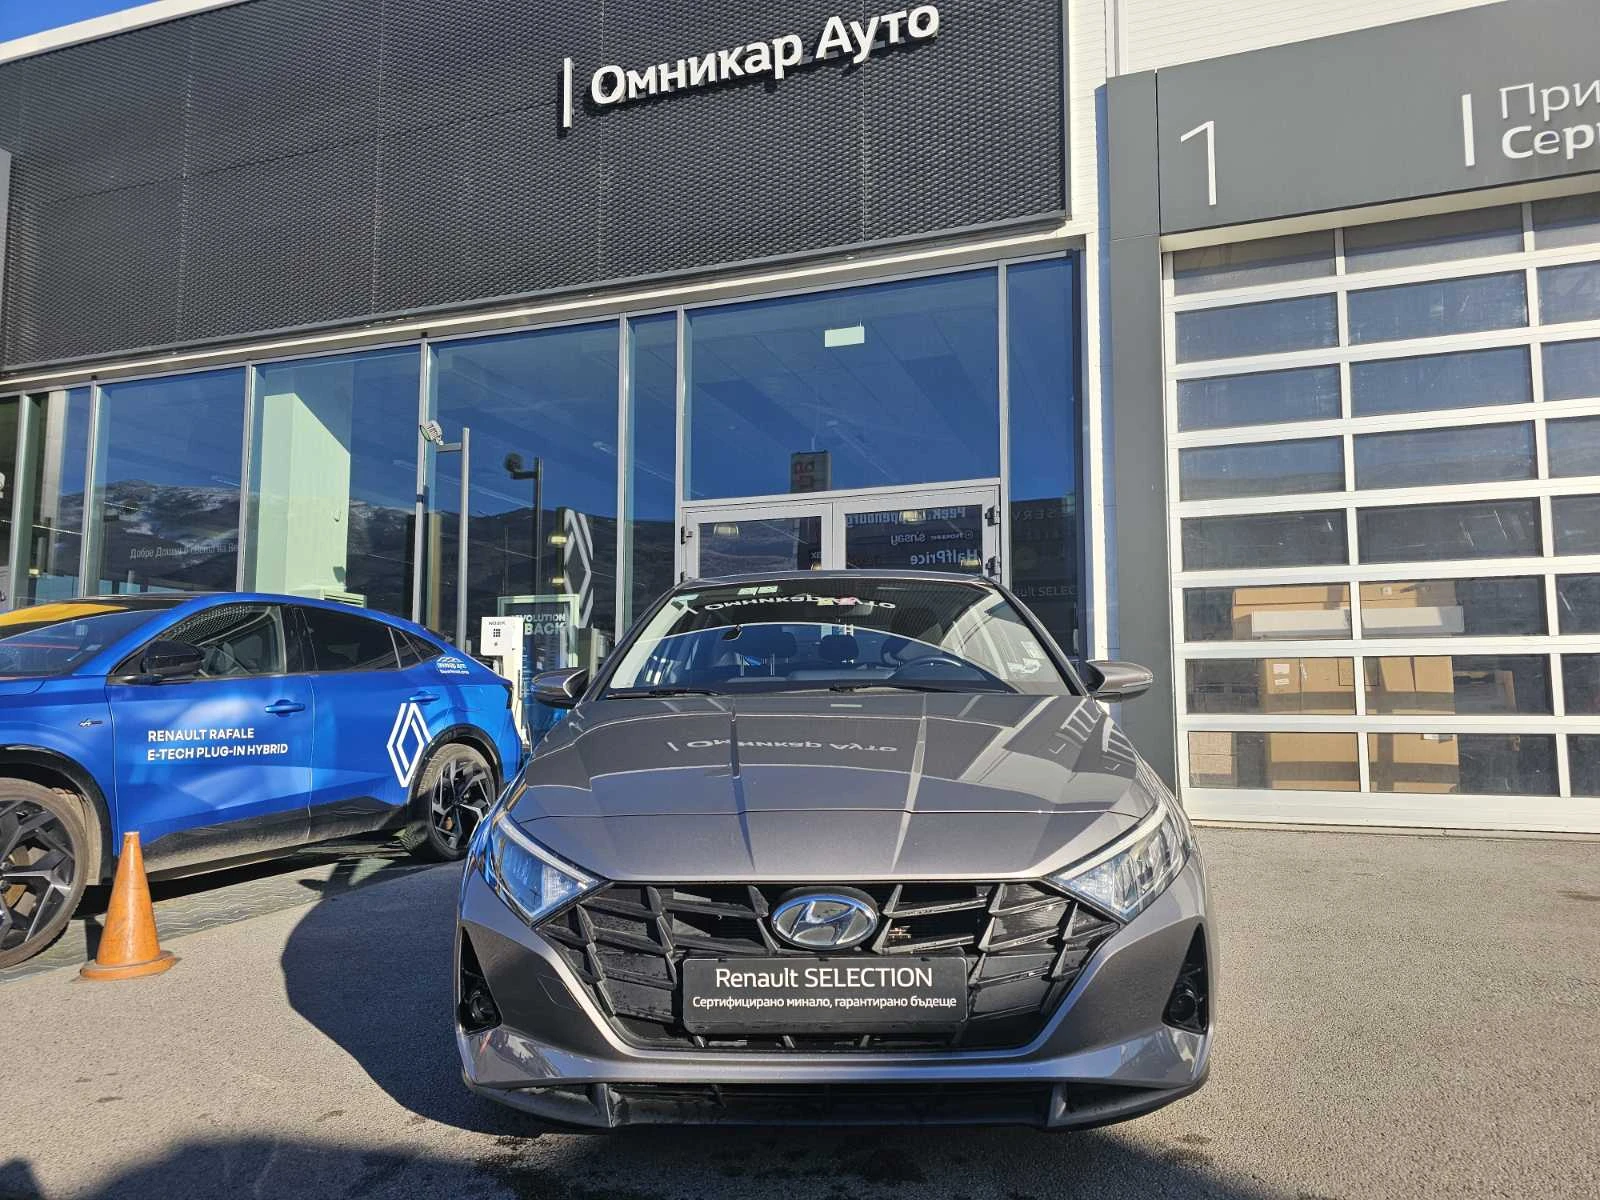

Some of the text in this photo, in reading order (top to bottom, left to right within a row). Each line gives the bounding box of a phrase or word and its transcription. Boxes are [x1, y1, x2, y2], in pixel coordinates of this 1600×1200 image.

[590, 4, 940, 105] Омникар Ауто
[1499, 79, 1600, 122] При
[1502, 122, 1600, 160] Сер
[1180, 120, 1218, 207] 1
[148, 728, 255, 742] RENAULT RAFALE
[147, 743, 289, 761] E-TECH PLUG-IN HYBRID
[716, 967, 933, 988] Renault SELECTION
[692, 995, 957, 1010] Сертифицирано минало, гарантирано бъдеще
